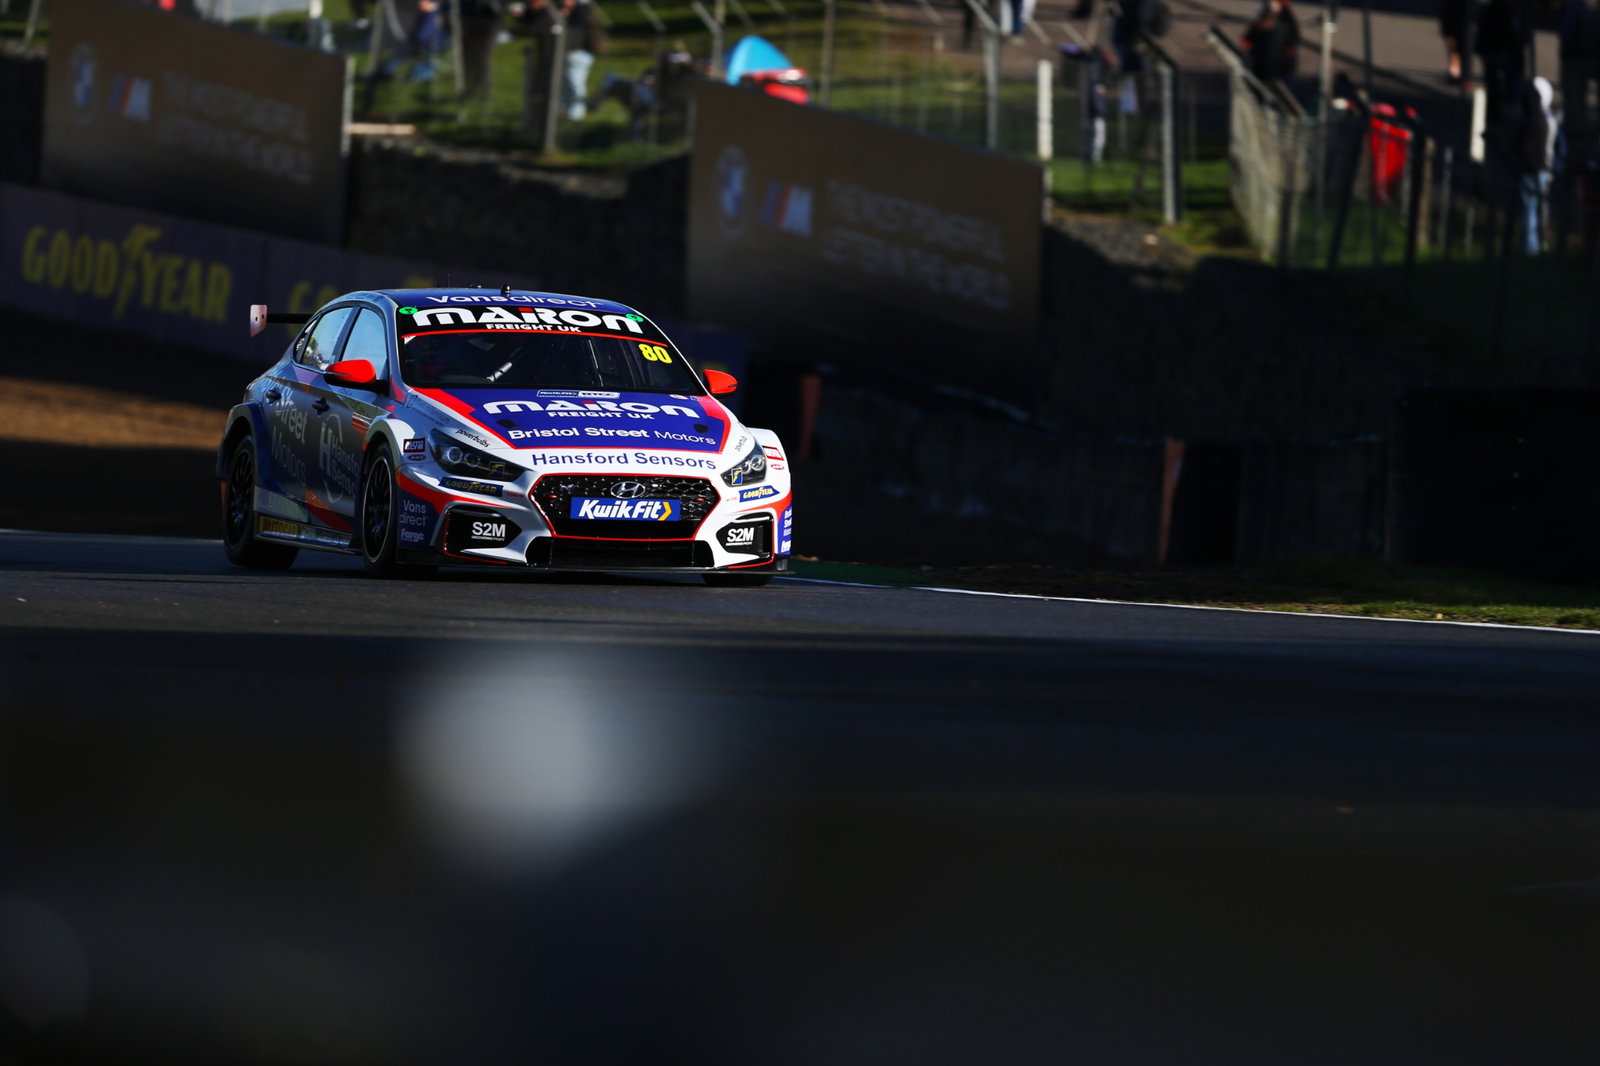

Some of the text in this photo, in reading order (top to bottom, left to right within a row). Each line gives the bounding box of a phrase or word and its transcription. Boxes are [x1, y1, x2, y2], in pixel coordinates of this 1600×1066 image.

[486, 323, 582, 333] FREIGHT UK
[639, 343, 672, 364] 80
[547, 410, 655, 420] FREIGHT UK
[507, 427, 716, 445] Bristol Street Motors
[531, 452, 717, 470] Hansford Sensors
[445, 479, 497, 494] GOODYEAR
[403, 499, 427, 514] Vans
[400, 512, 426, 528] direct
[472, 521, 506, 538] S2M
[727, 527, 755, 542] S2M
